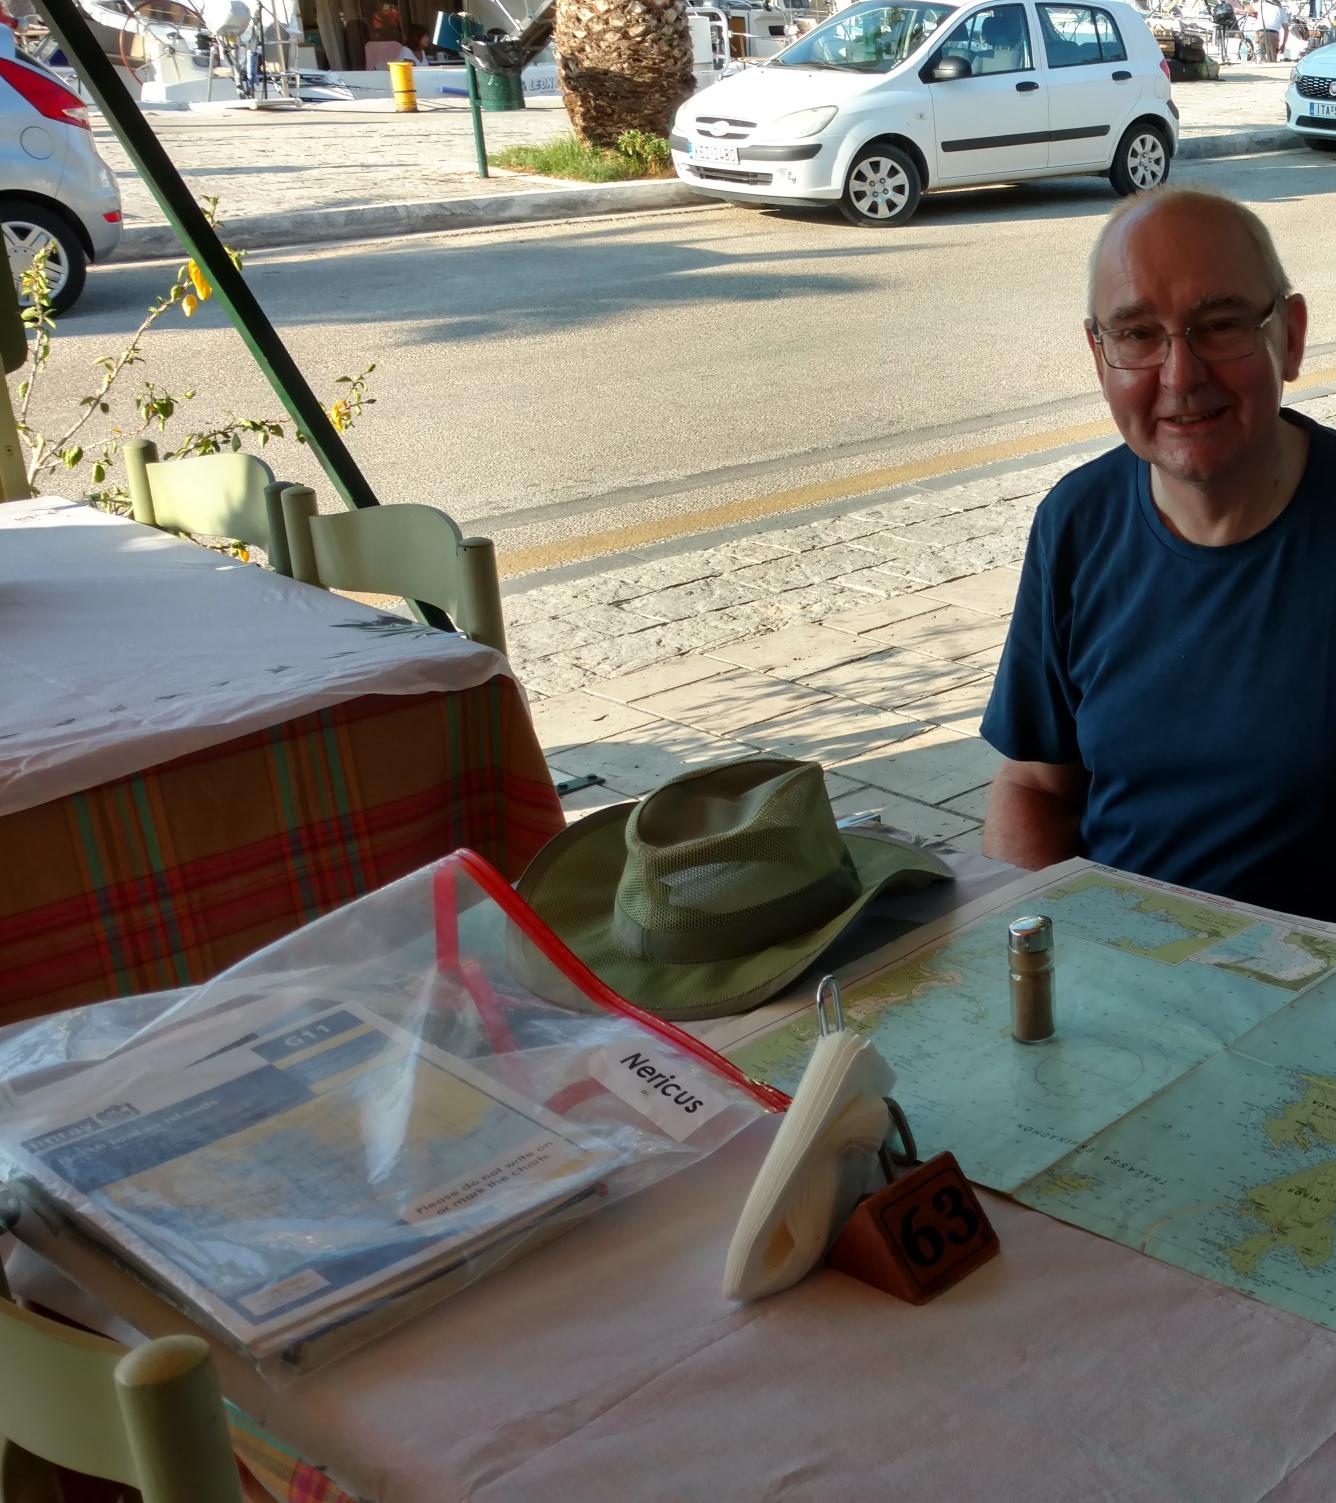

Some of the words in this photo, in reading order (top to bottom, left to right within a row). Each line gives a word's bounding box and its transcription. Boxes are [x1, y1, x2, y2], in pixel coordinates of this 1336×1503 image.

[285, 1025, 330, 1046] G11
[620, 1053, 704, 1113] Nericus
[415, 1190, 459, 1215] Please
[461, 1179, 480, 1191] do
[481, 1168, 503, 1181] not
[504, 1151, 535, 1169] write
[536, 1141, 554, 1152] on
[436, 1207, 450, 1216] or
[453, 1187, 485, 1208] mark
[486, 1175, 510, 1189] the
[511, 1153, 550, 1177] charts
[1103, 1155, 1168, 1185] THALASSA
[1288, 1188, 1321, 1203] NISOS
[901, 1185, 980, 1268] 63
